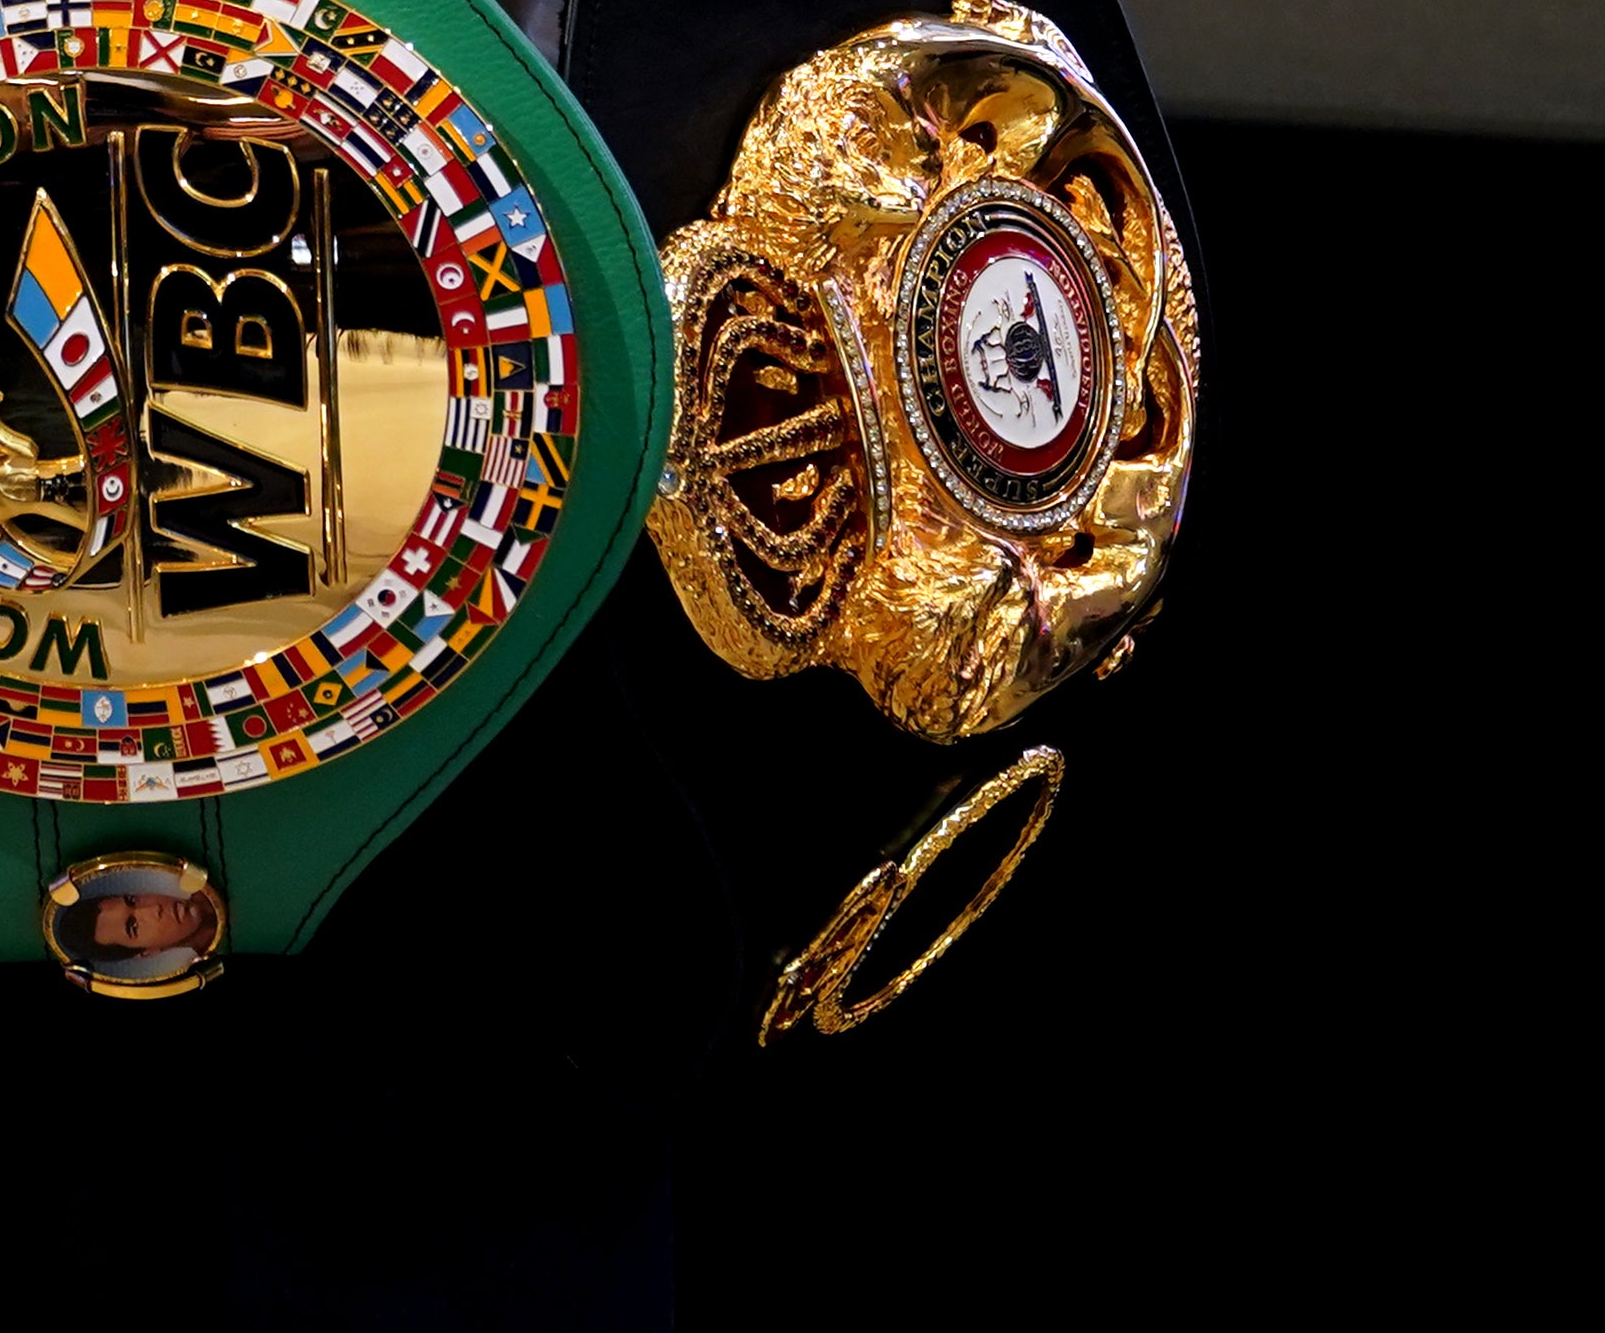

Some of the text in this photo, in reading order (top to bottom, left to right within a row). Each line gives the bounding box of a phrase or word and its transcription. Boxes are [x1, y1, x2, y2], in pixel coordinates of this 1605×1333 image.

[133, 121, 317, 620] WBC
[916, 210, 1040, 503] SUPER CHAMPION
[940, 268, 969, 374] BOXING
